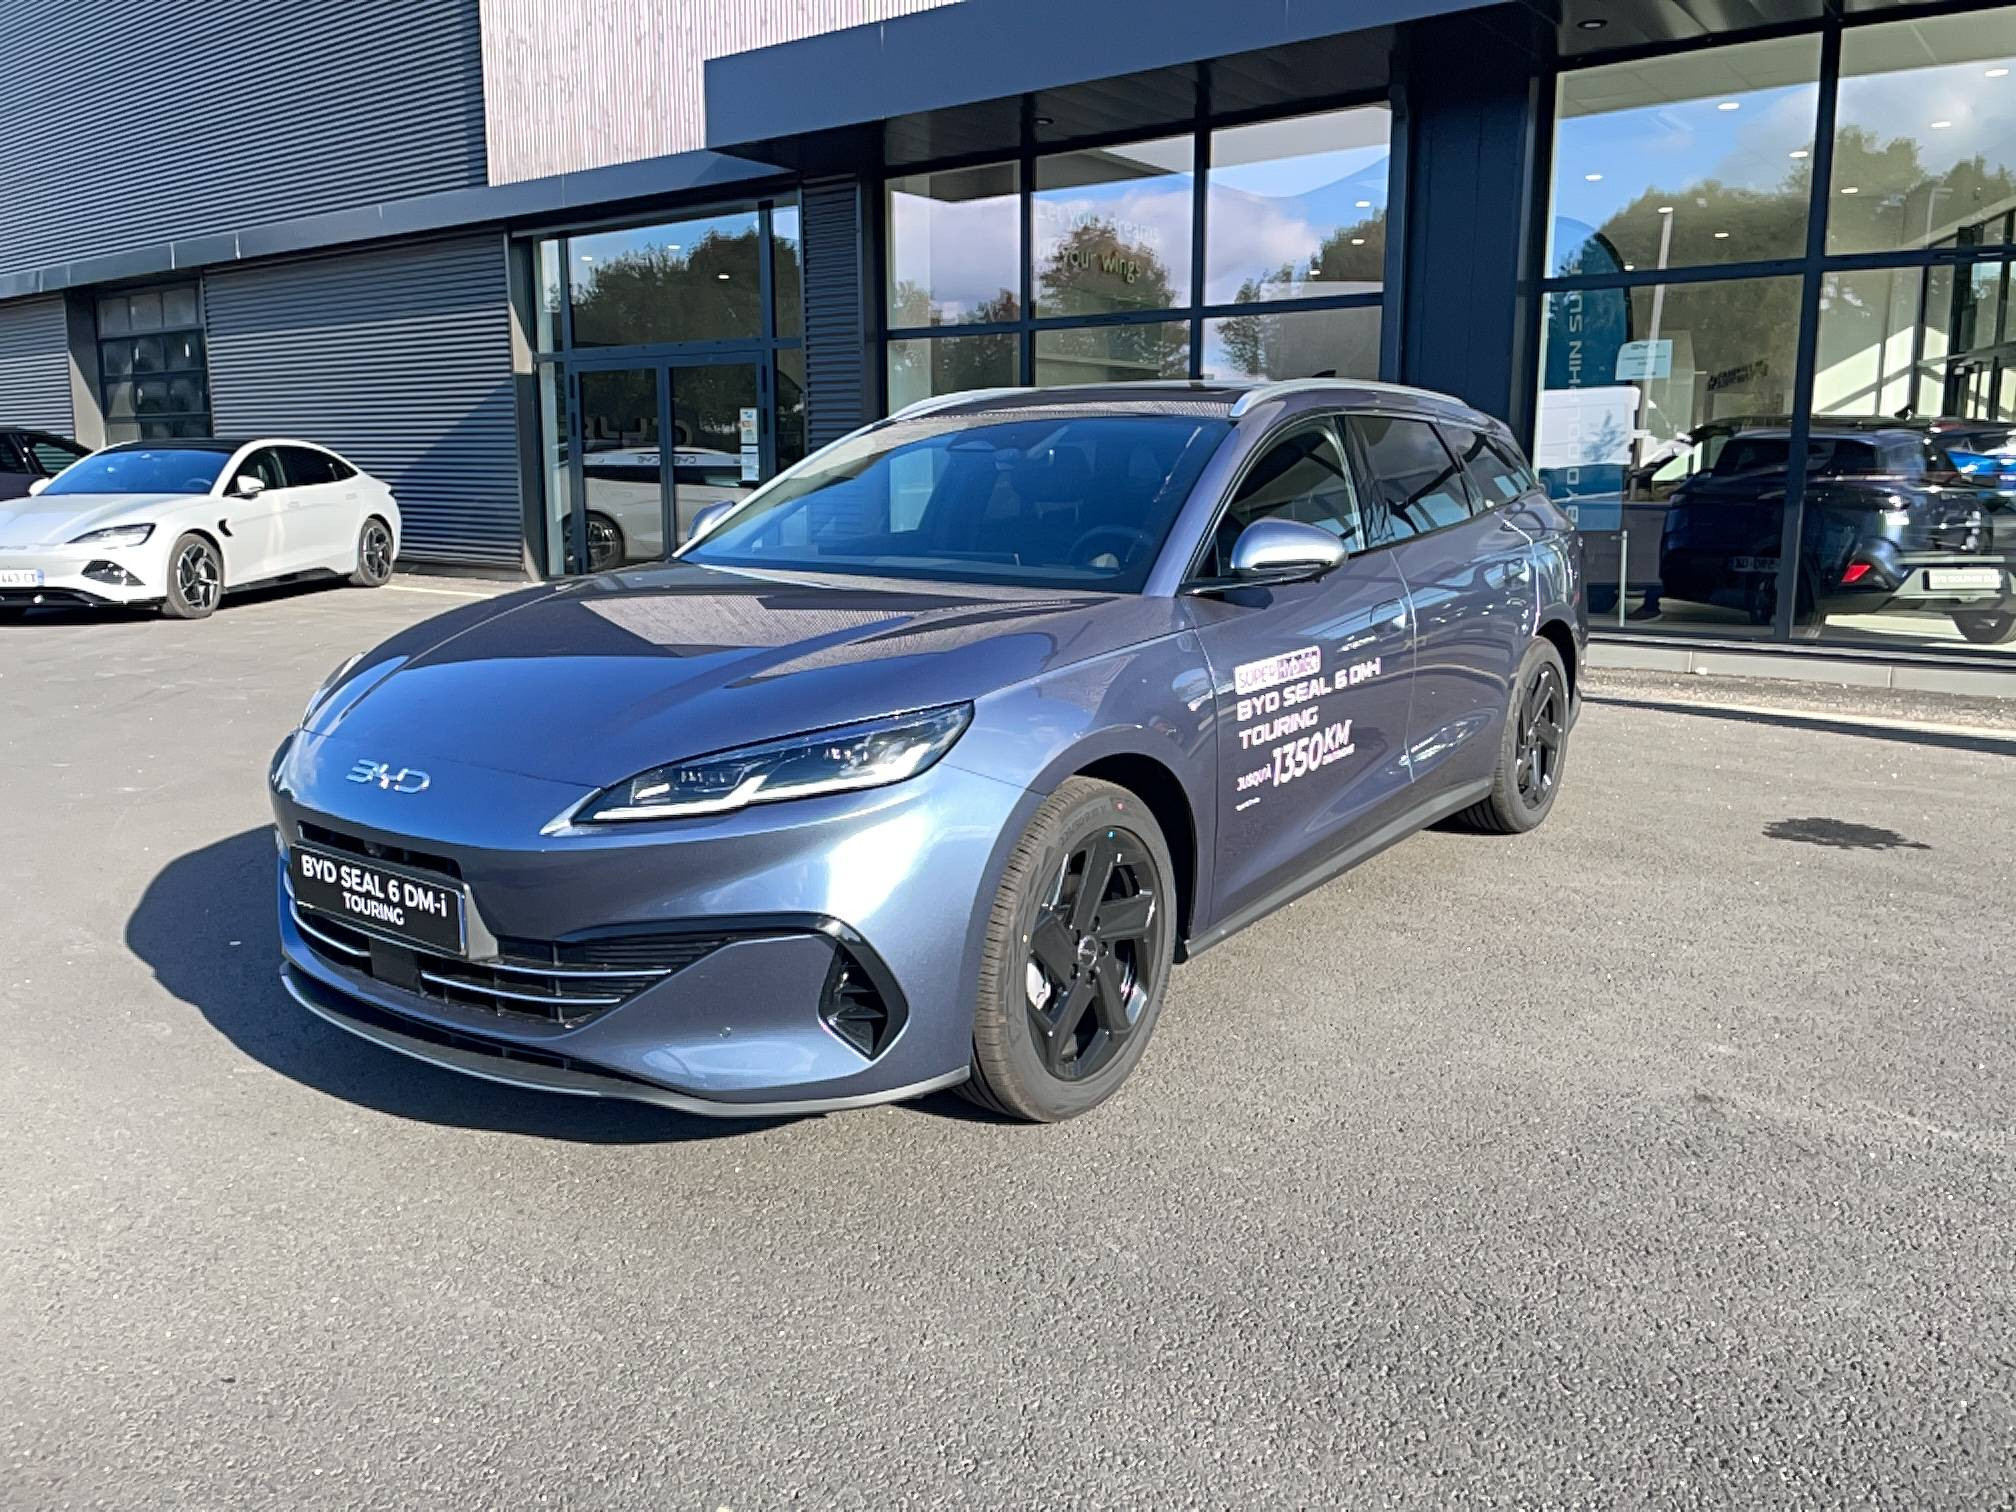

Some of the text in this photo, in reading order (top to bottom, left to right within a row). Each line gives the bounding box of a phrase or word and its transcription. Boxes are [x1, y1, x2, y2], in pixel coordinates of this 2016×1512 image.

[1102, 252, 1141, 284] wings
[1236, 691, 1280, 721] BYD
[1282, 677, 1332, 708] SEAL
[1334, 669, 1348, 690] 6
[1238, 705, 1319, 750] TOURING
[345, 759, 430, 793] BYD
[300, 854, 448, 917] BYD SEAL 6 DM-i
[342, 891, 405, 926] TOURING
